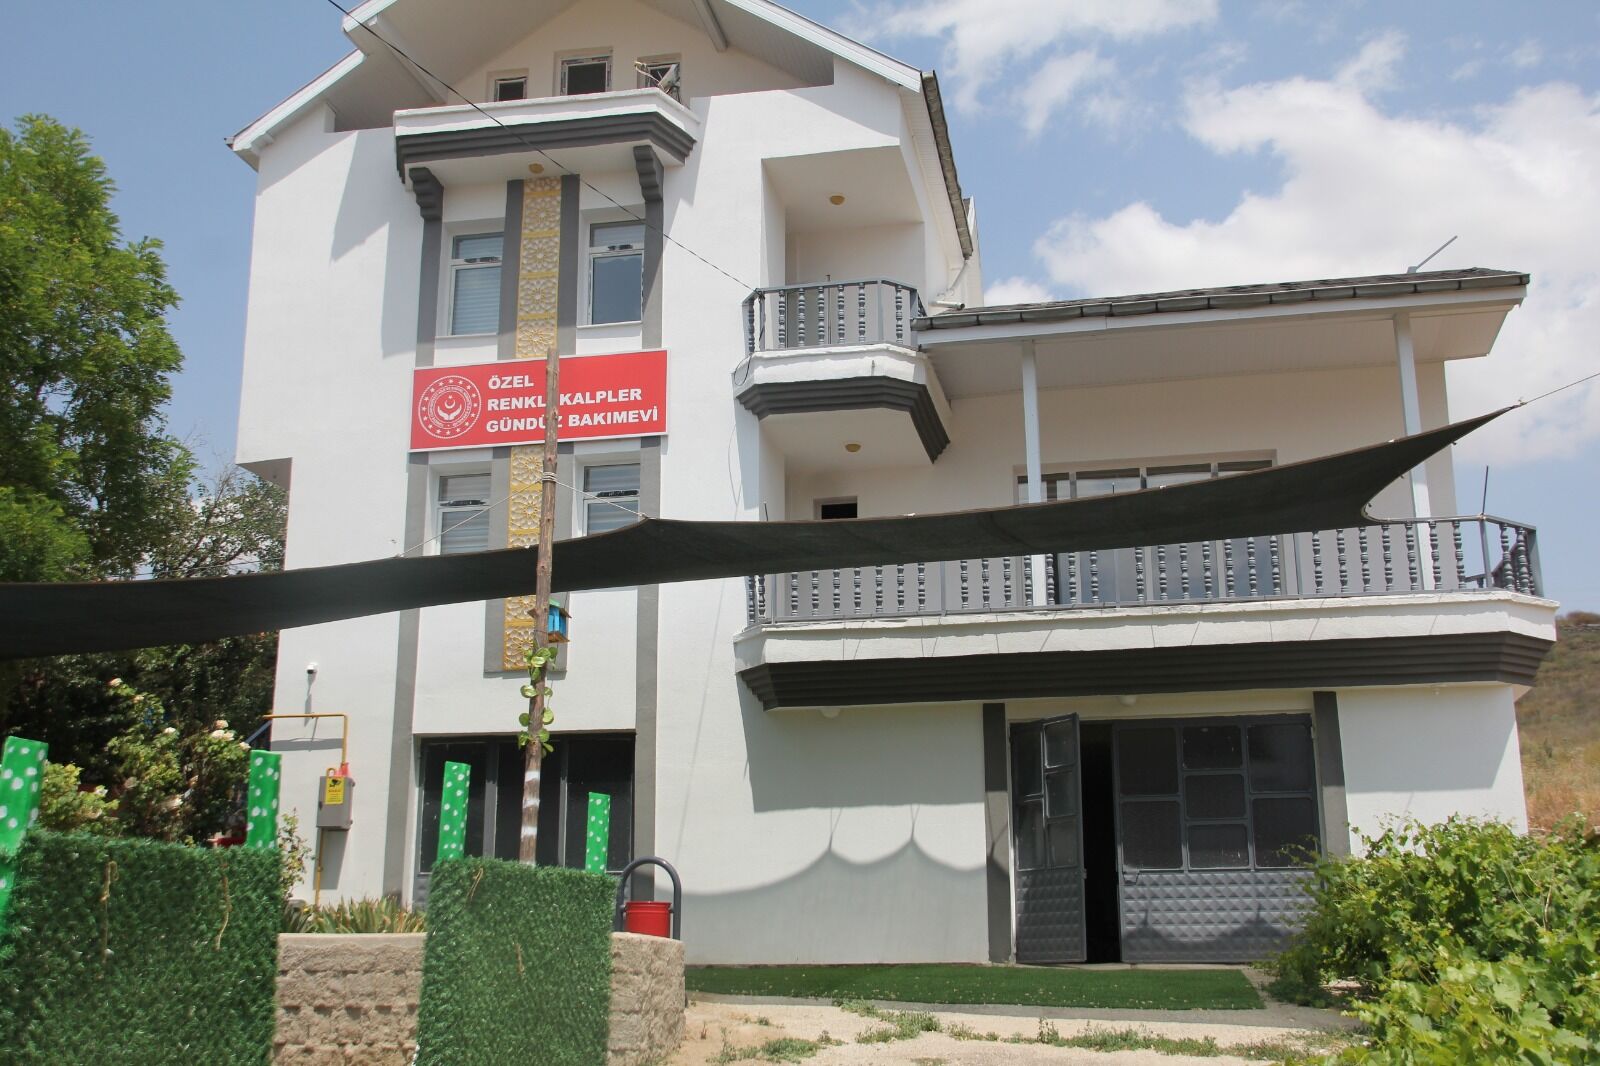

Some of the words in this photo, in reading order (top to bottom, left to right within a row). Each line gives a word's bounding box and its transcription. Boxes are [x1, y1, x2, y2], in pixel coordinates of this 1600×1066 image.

[488, 375, 534, 390] ÖZEL
[487, 396, 547, 411] RENKL
[559, 388, 642, 406] KALPLER
[568, 406, 658, 427] BAKIMEVİ
